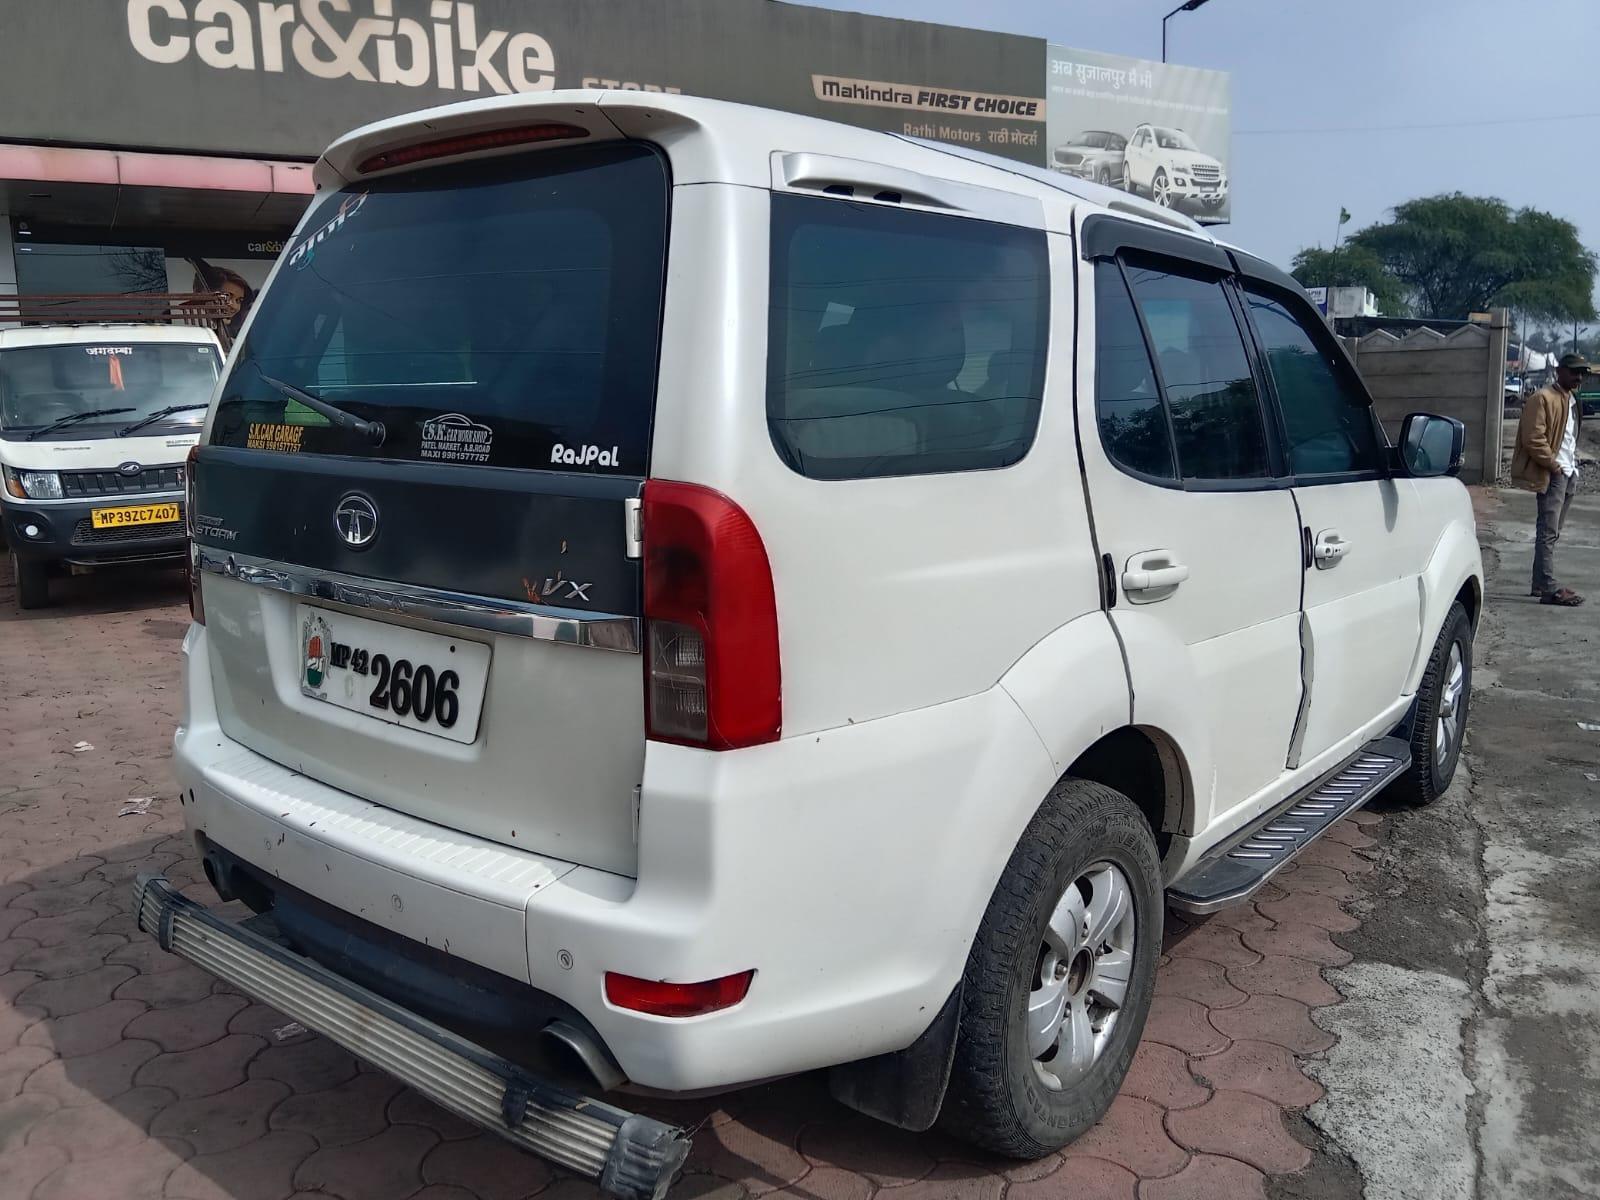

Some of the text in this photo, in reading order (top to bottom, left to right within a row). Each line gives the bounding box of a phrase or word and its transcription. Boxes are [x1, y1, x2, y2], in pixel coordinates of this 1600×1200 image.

[127, 0, 555, 94] car&bike
[1051, 60, 1072, 76] अब
[1076, 63, 1126, 90] सुजालपुर
[822, 80, 1038, 116] Mahindra FIRST CHOICE
[903, 122, 981, 142] Rathi Motors
[987, 128, 1009, 144] राठी
[274, 424, 305, 443] GARAGE
[420, 449, 441, 459] MAXI
[421, 440, 437, 450] PATEL
[100, 507, 177, 525] MP39ZC7407
[330, 641, 460, 729] MP 42 2606
